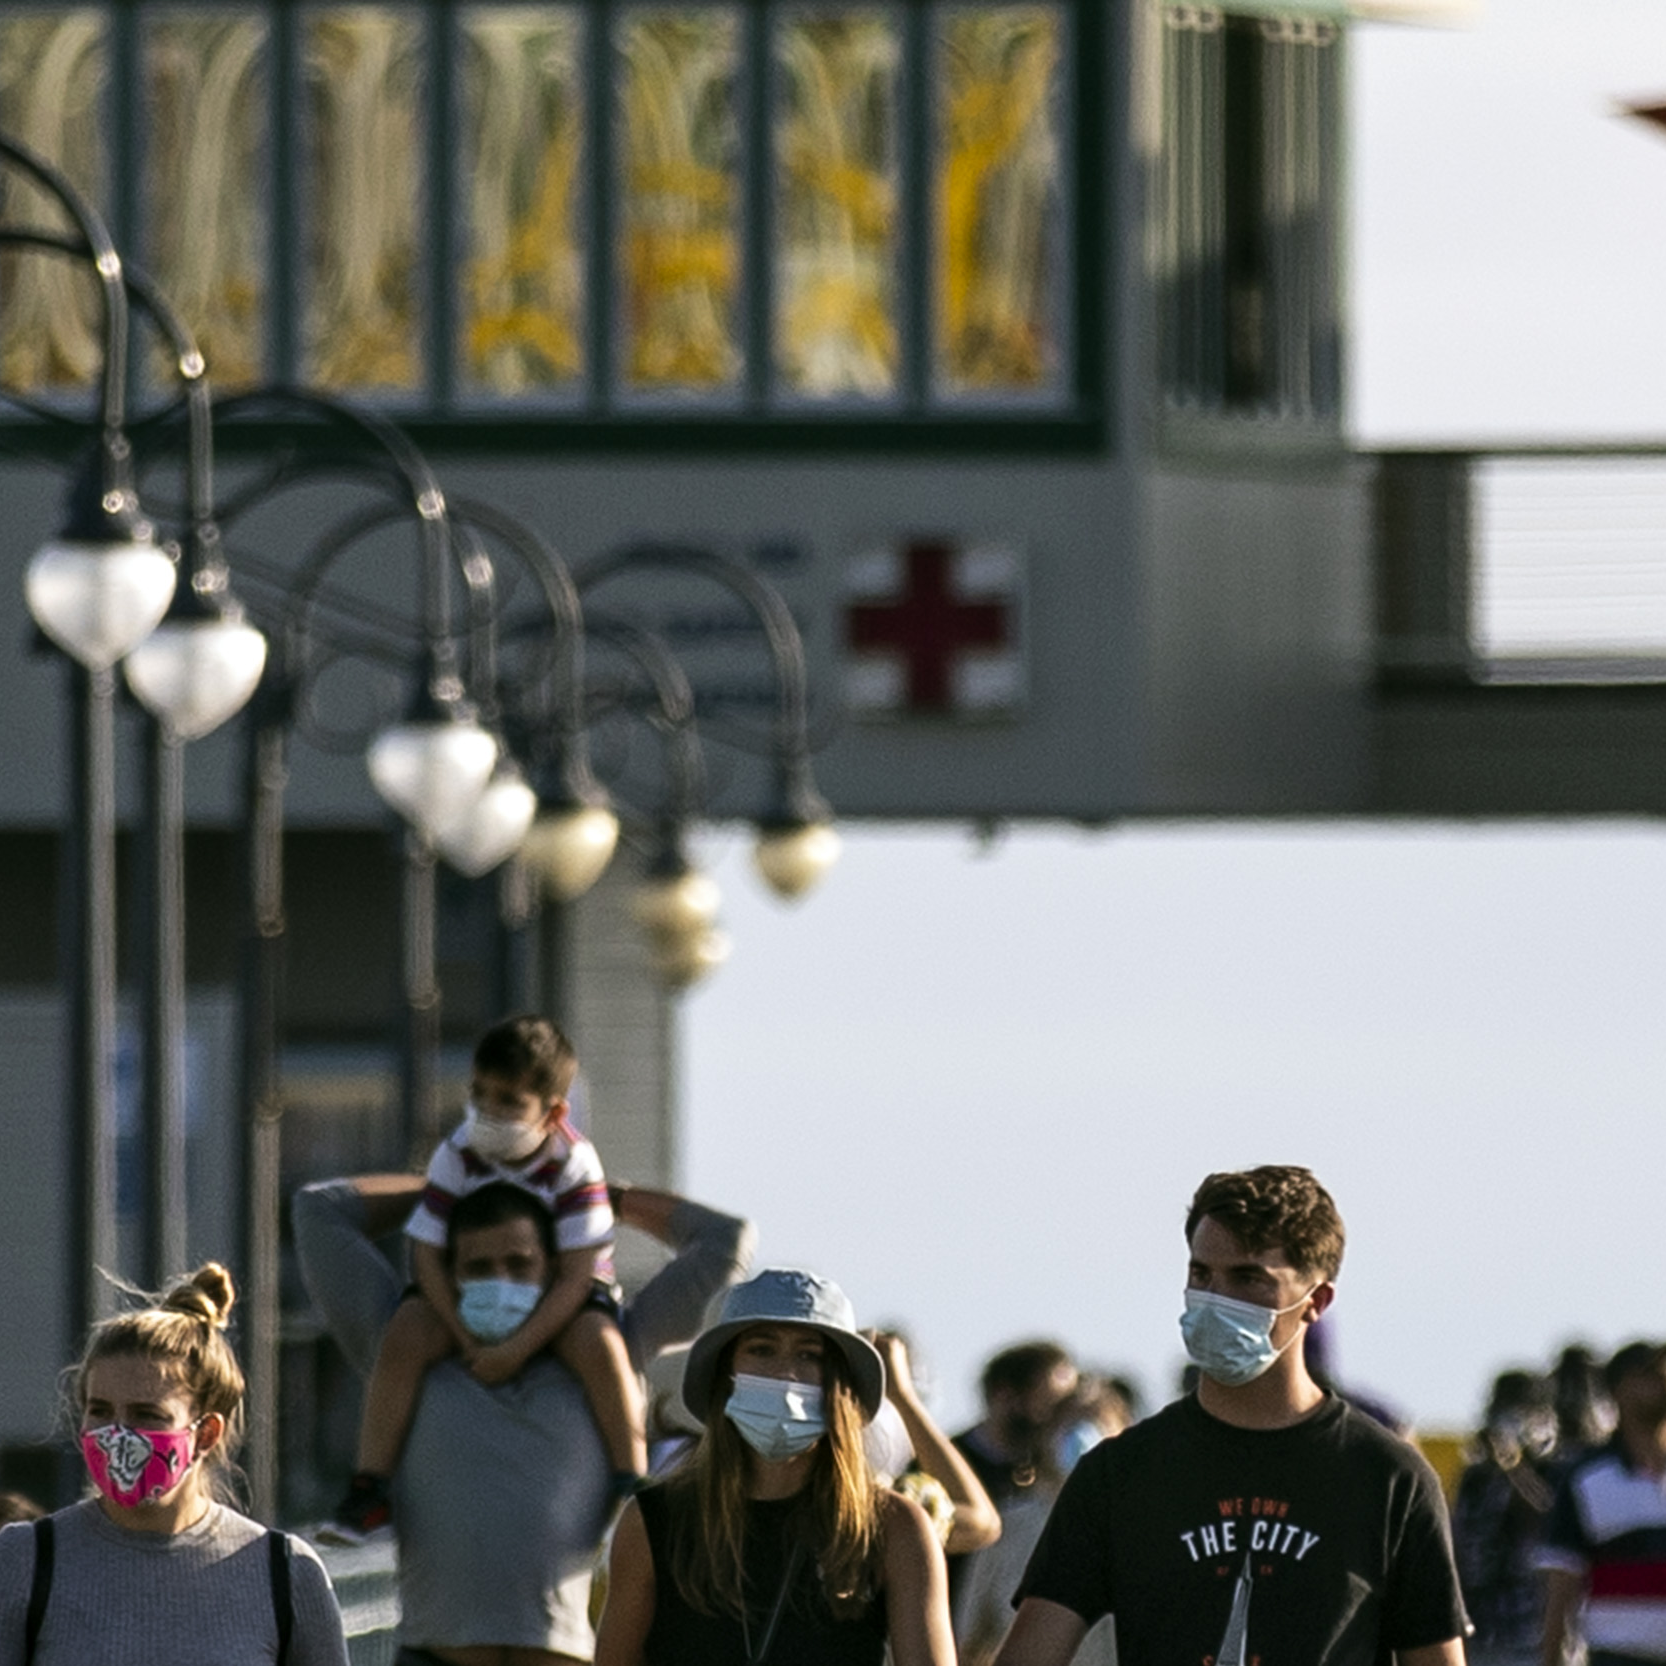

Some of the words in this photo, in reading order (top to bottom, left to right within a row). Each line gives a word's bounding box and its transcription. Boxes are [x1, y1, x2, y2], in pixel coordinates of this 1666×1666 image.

[1217, 1498, 1244, 1516] WE
[1180, 1521, 1237, 1561] THE
[1251, 1520, 1320, 1560] CITY
